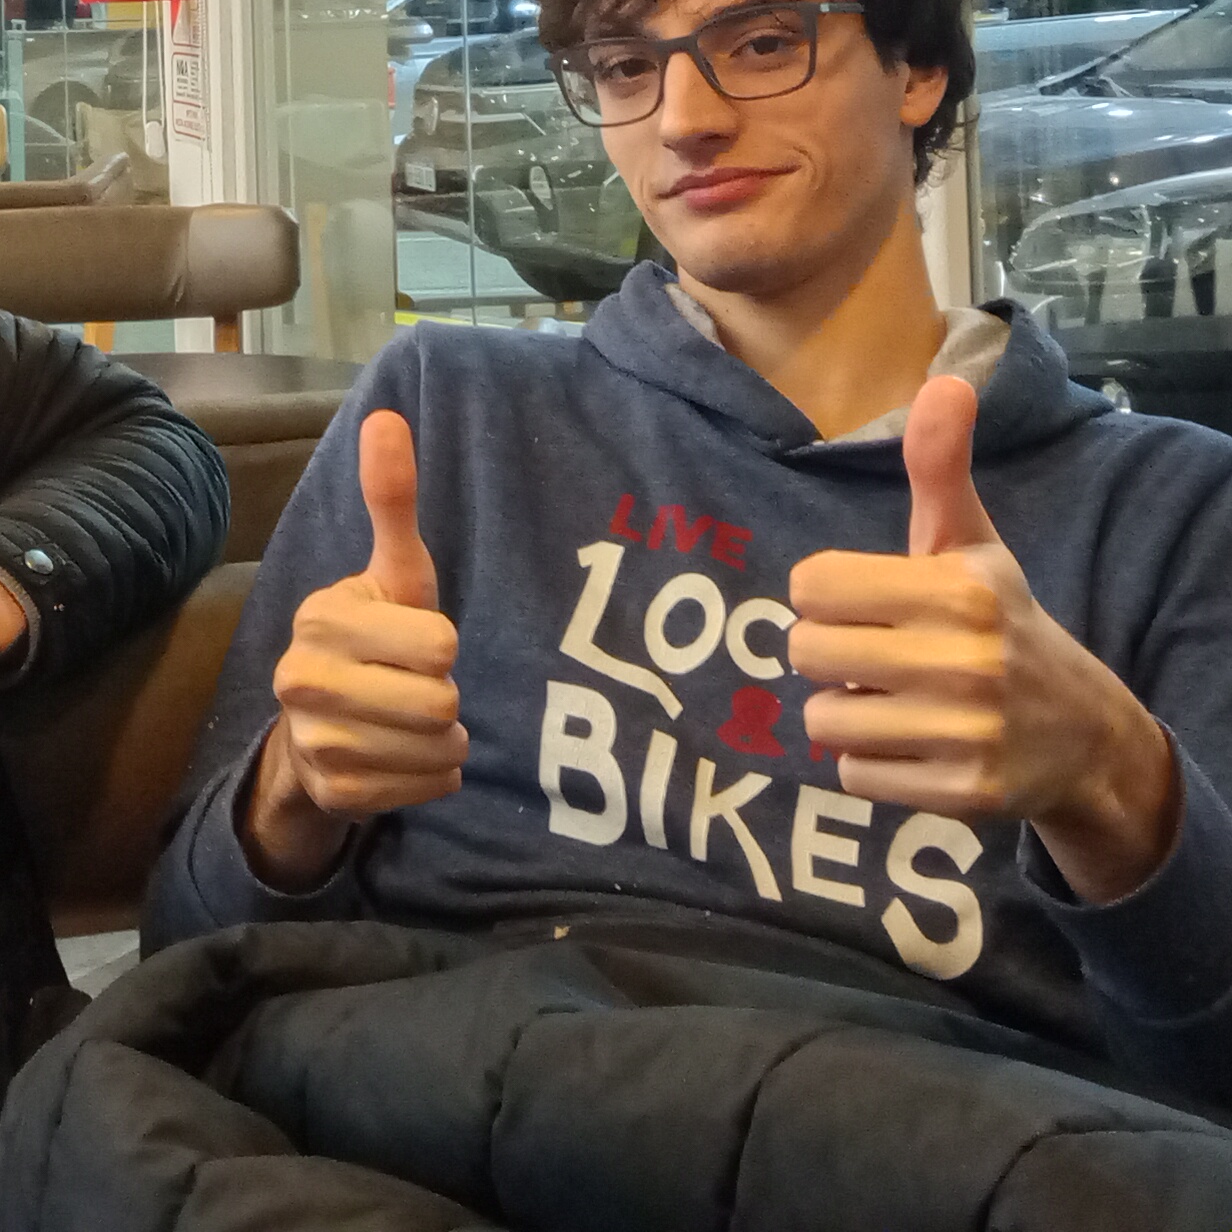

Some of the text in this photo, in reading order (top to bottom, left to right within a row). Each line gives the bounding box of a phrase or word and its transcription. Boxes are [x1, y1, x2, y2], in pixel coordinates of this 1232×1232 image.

[609, 493, 753, 572] LIVE
[559, 540, 799, 720] LOC
[539, 680, 984, 981] BIKES
